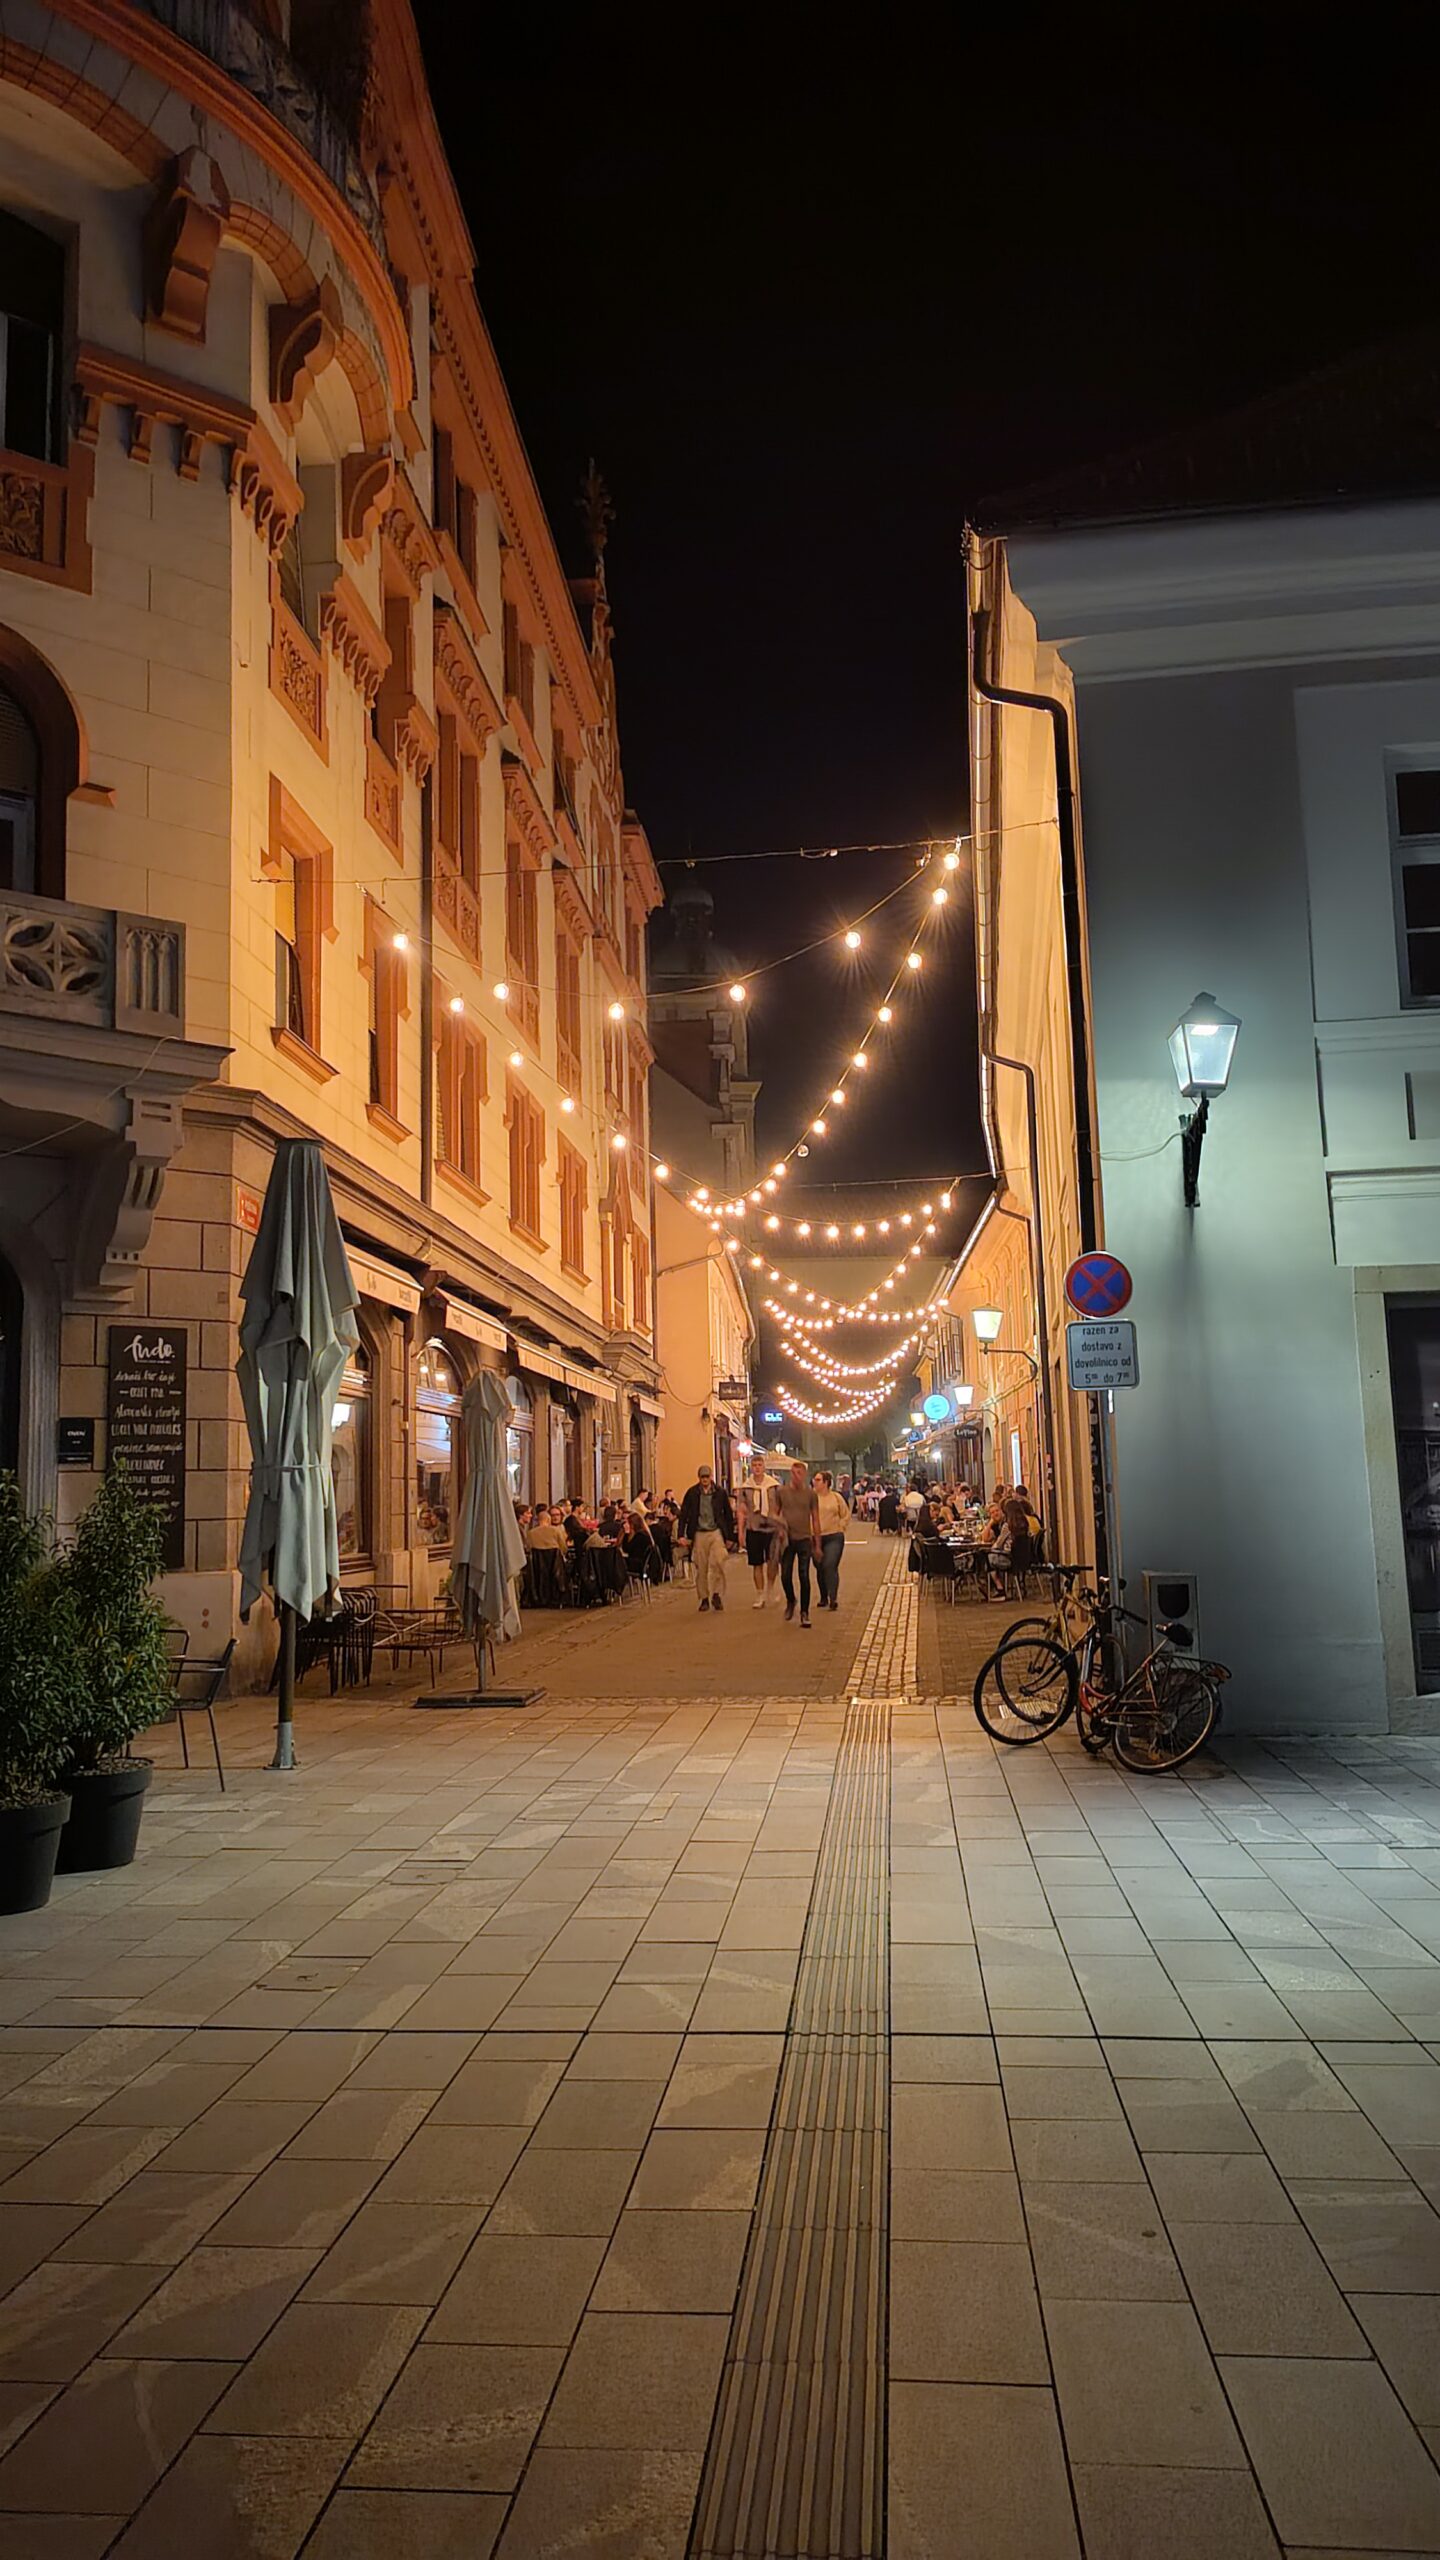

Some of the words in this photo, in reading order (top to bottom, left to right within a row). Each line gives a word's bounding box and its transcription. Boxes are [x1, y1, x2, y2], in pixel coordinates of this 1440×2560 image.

[1082, 1326, 1106, 1336] razen
[1109, 1326, 1119, 1335] za
[1081, 1341, 1114, 1352] dostavo
[1117, 1342, 1122, 1351] z
[1075, 1357, 1118, 1369] dovolilnico
[1121, 1355, 1132, 1367] od
[1103, 1373, 1114, 1383] do
